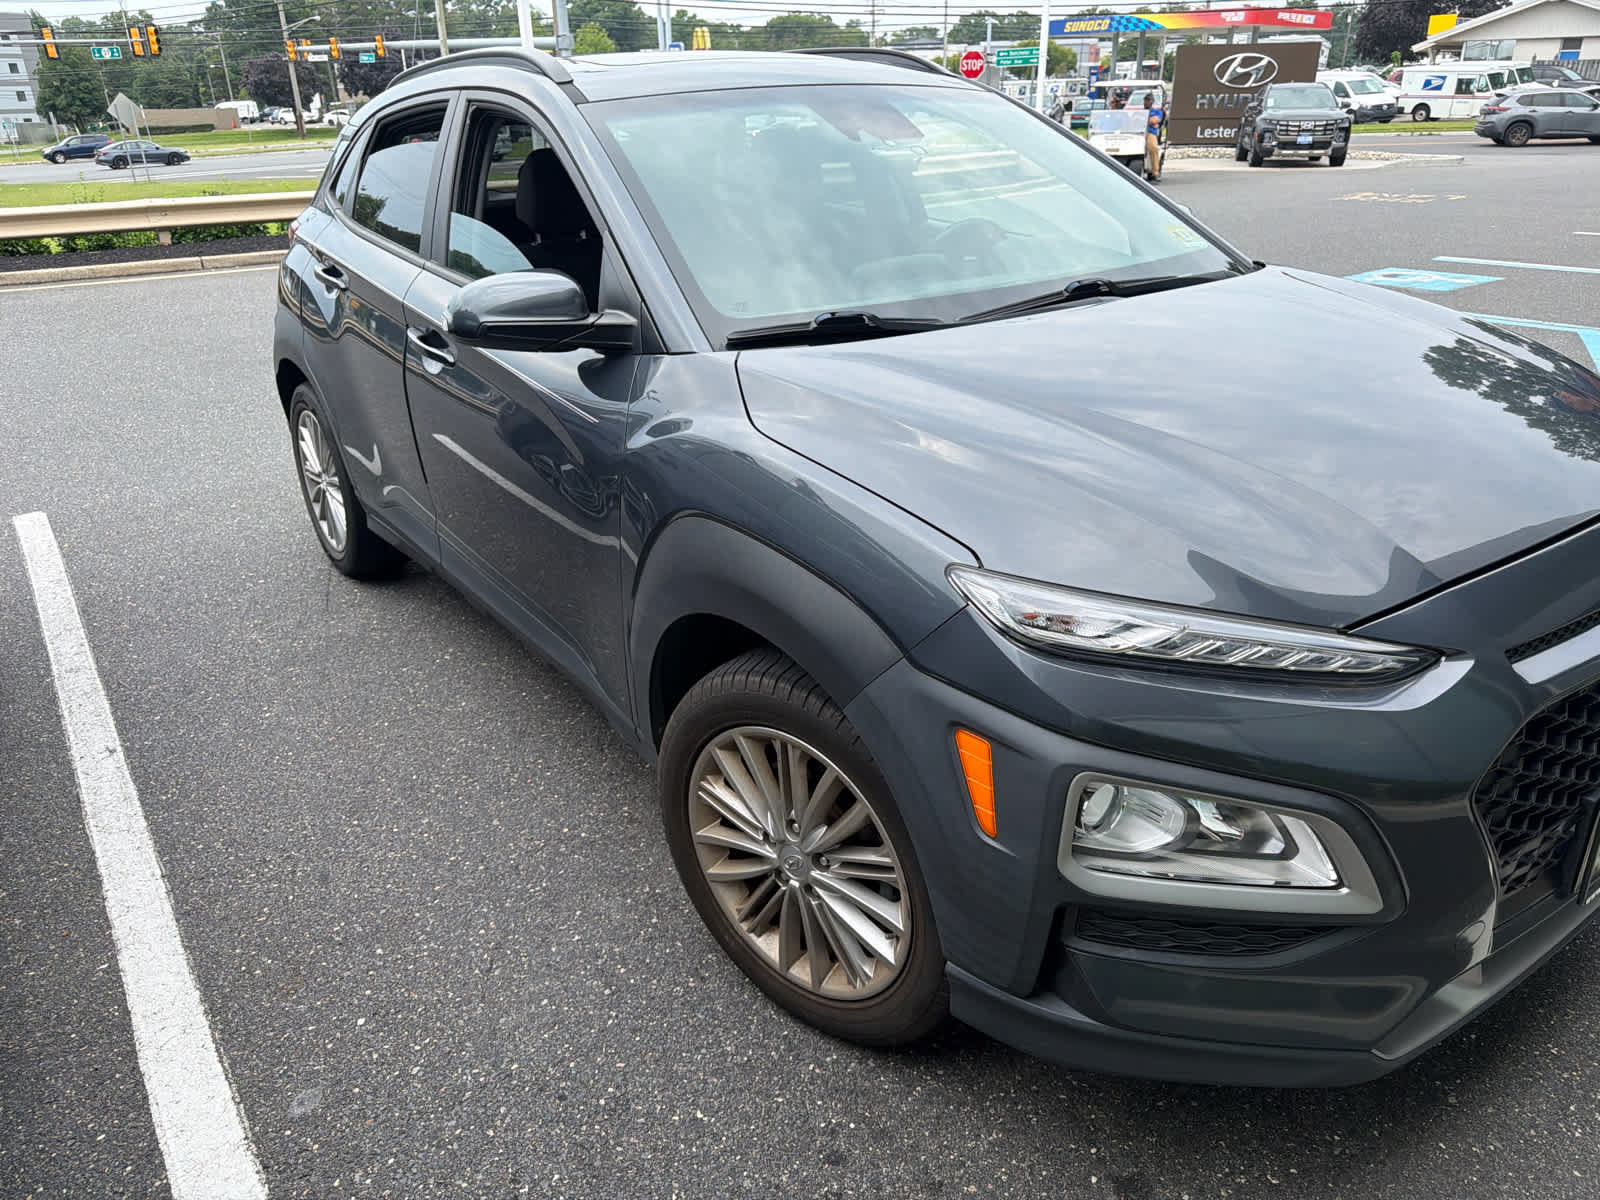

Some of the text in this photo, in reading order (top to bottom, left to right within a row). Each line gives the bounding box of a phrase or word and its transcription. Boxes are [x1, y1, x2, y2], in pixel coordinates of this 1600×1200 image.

[1064, 19, 1110, 32] SUNOCO
[961, 58, 984, 71] STOP
[1196, 93, 1257, 109] HYUN
[1196, 125, 1238, 138] Lester
